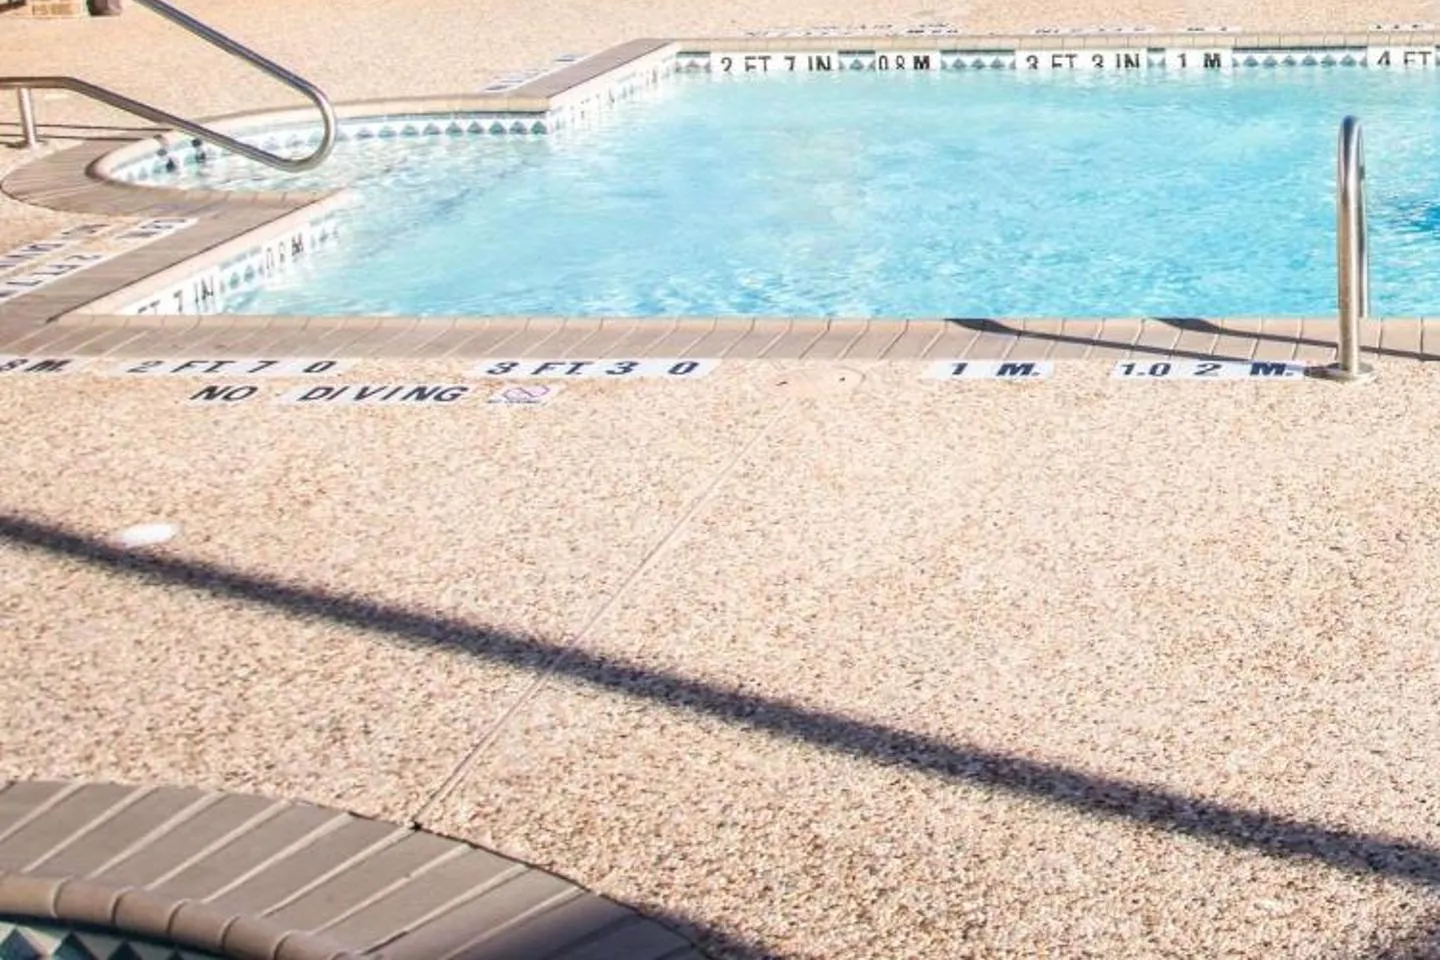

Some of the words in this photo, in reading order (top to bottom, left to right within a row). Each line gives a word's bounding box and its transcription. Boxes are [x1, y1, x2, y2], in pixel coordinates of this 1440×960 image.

[126, 360, 164, 374] 2
[486, 361, 519, 375] 3
[605, 361, 640, 375] 3
[952, 362, 968, 376] 1
[190, 385, 258, 402] NO
[298, 385, 467, 402] DIVING
